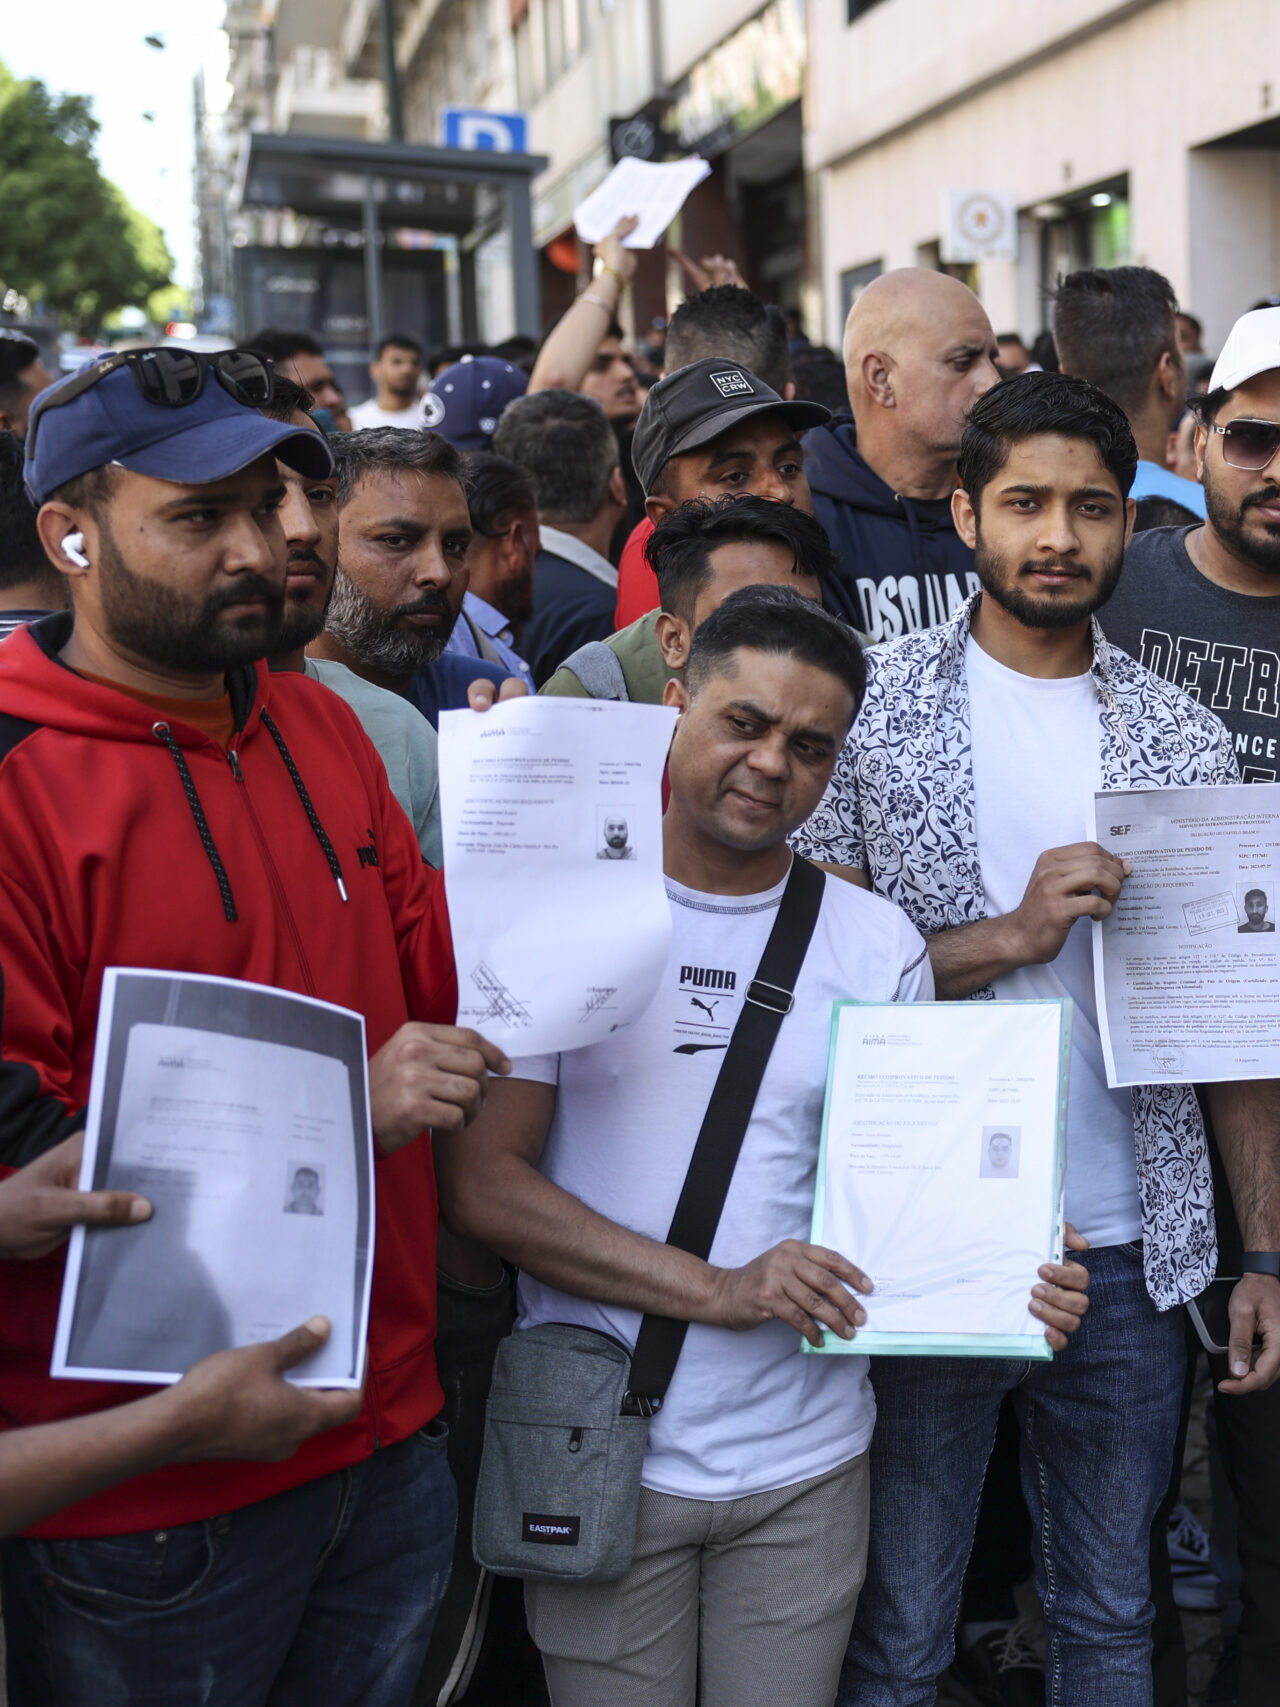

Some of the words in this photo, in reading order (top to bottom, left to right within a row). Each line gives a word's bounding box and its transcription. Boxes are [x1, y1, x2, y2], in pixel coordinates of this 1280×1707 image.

[716, 374, 741, 384] NYC
[722, 383, 747, 392] CRW
[1228, 731, 1277, 759] NCE
[1170, 816, 1201, 824] MINISTÉRIO
[1210, 813, 1255, 821] ADMINISTRAÇÃO
[1110, 825, 1131, 837] SEF
[1134, 848, 1177, 856] COMPROVATIVO
[1162, 881, 1194, 889] REQUERENTE
[1178, 942, 1212, 950] NOTIFICAÇÃO
[680, 965, 737, 990] PUMA
[862, 1038, 886, 1046] AIMA
[529, 1523, 570, 1535] EASTPAK
